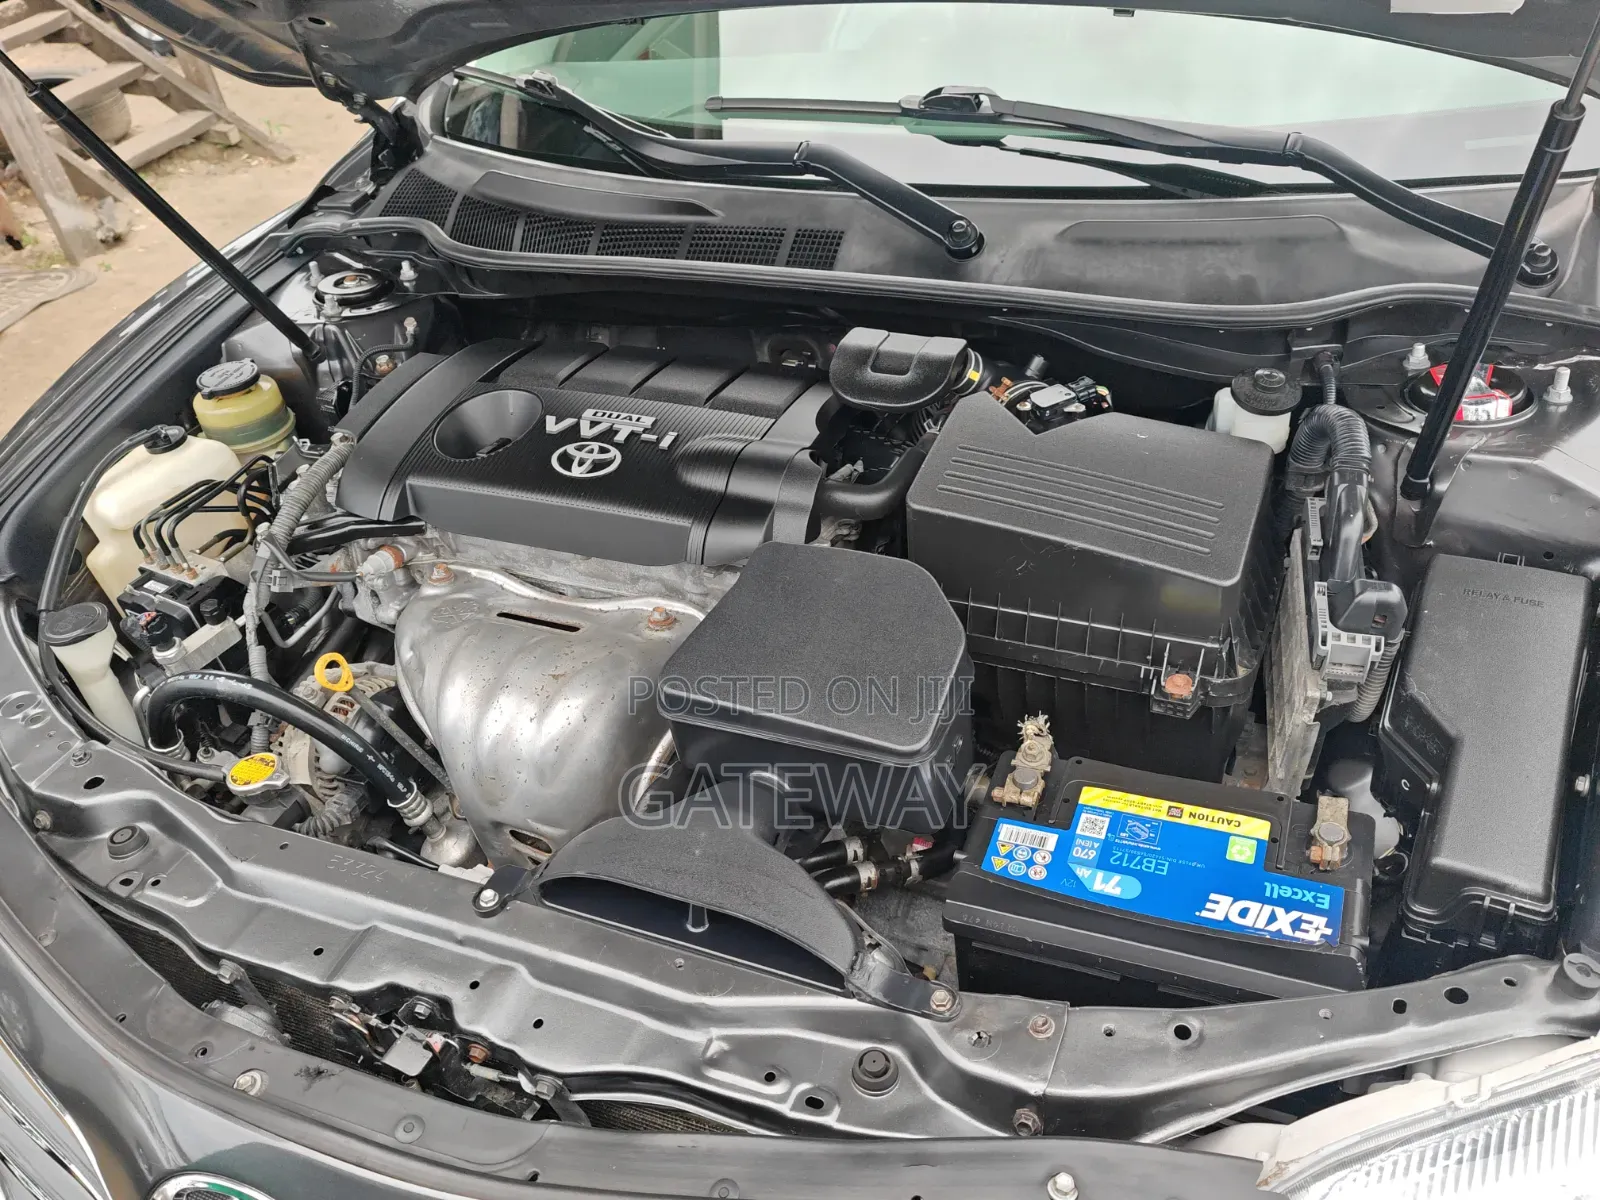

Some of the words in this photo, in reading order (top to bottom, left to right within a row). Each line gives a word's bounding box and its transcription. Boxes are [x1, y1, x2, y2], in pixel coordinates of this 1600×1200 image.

[591, 410, 646, 424] DUAL
[545, 415, 679, 450] VVT-i
[1463, 588, 1501, 600] RELAY
[1502, 594, 1511, 602] &
[1513, 596, 1545, 608] FUSE
[1188, 811, 1241, 828] CAUTION
[1072, 846, 1097, 860] 670
[1109, 850, 1169, 876] EB712
[1076, 867, 1092, 878] Ah
[1060, 878, 1077, 888] 12V
[1093, 871, 1122, 895] 71
[1264, 881, 1331, 910] Excell
[1199, 892, 1333, 942] EXIDE
